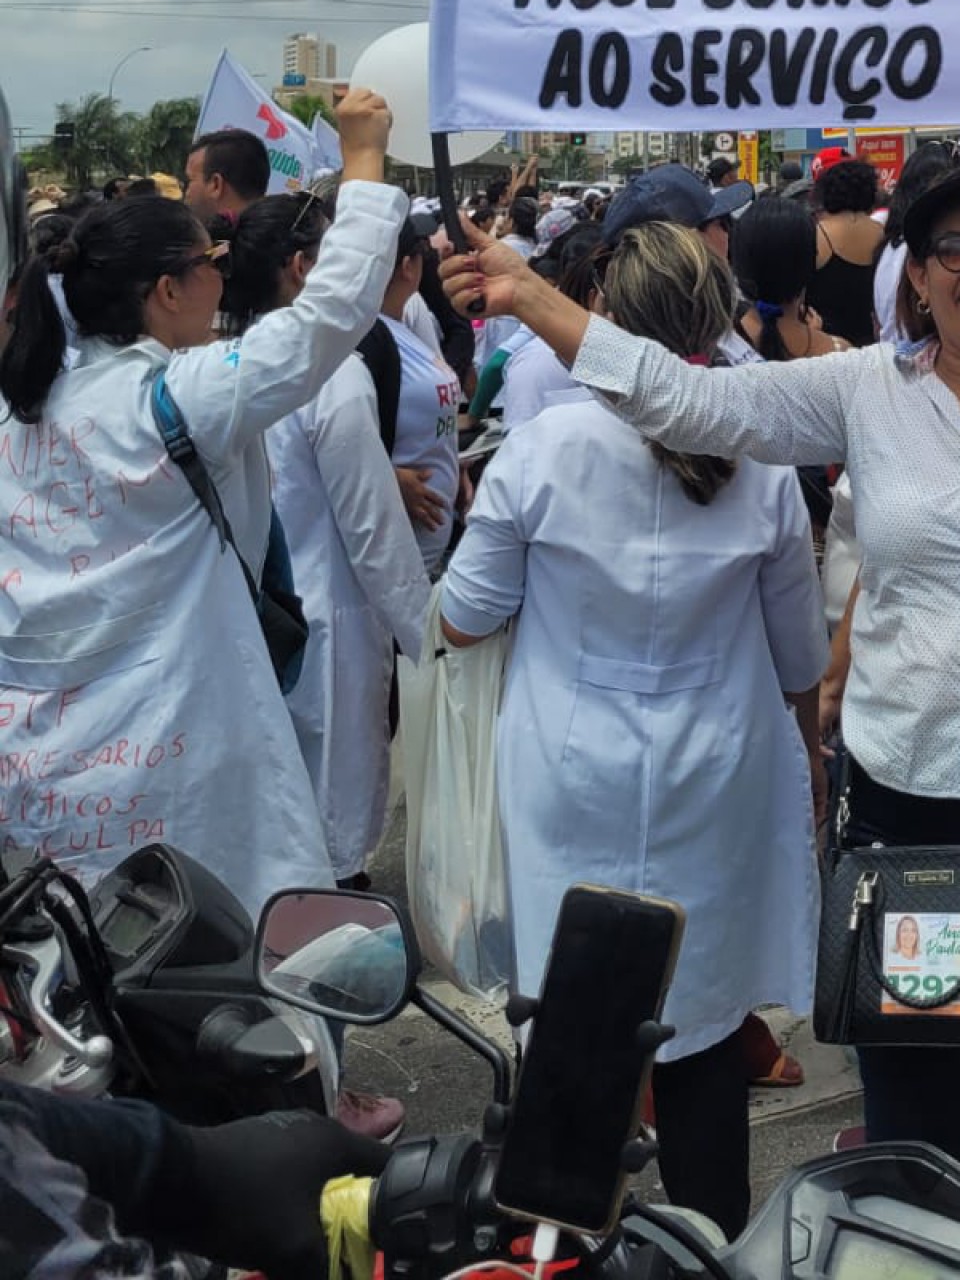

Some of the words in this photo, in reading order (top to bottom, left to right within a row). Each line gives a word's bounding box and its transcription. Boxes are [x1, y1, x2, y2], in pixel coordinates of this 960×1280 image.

[538, 29, 630, 109] AO
[650, 26, 942, 120] SERVIÇO
[0, 417, 96, 478] NFER
[39, 818, 165, 858] CULPA
